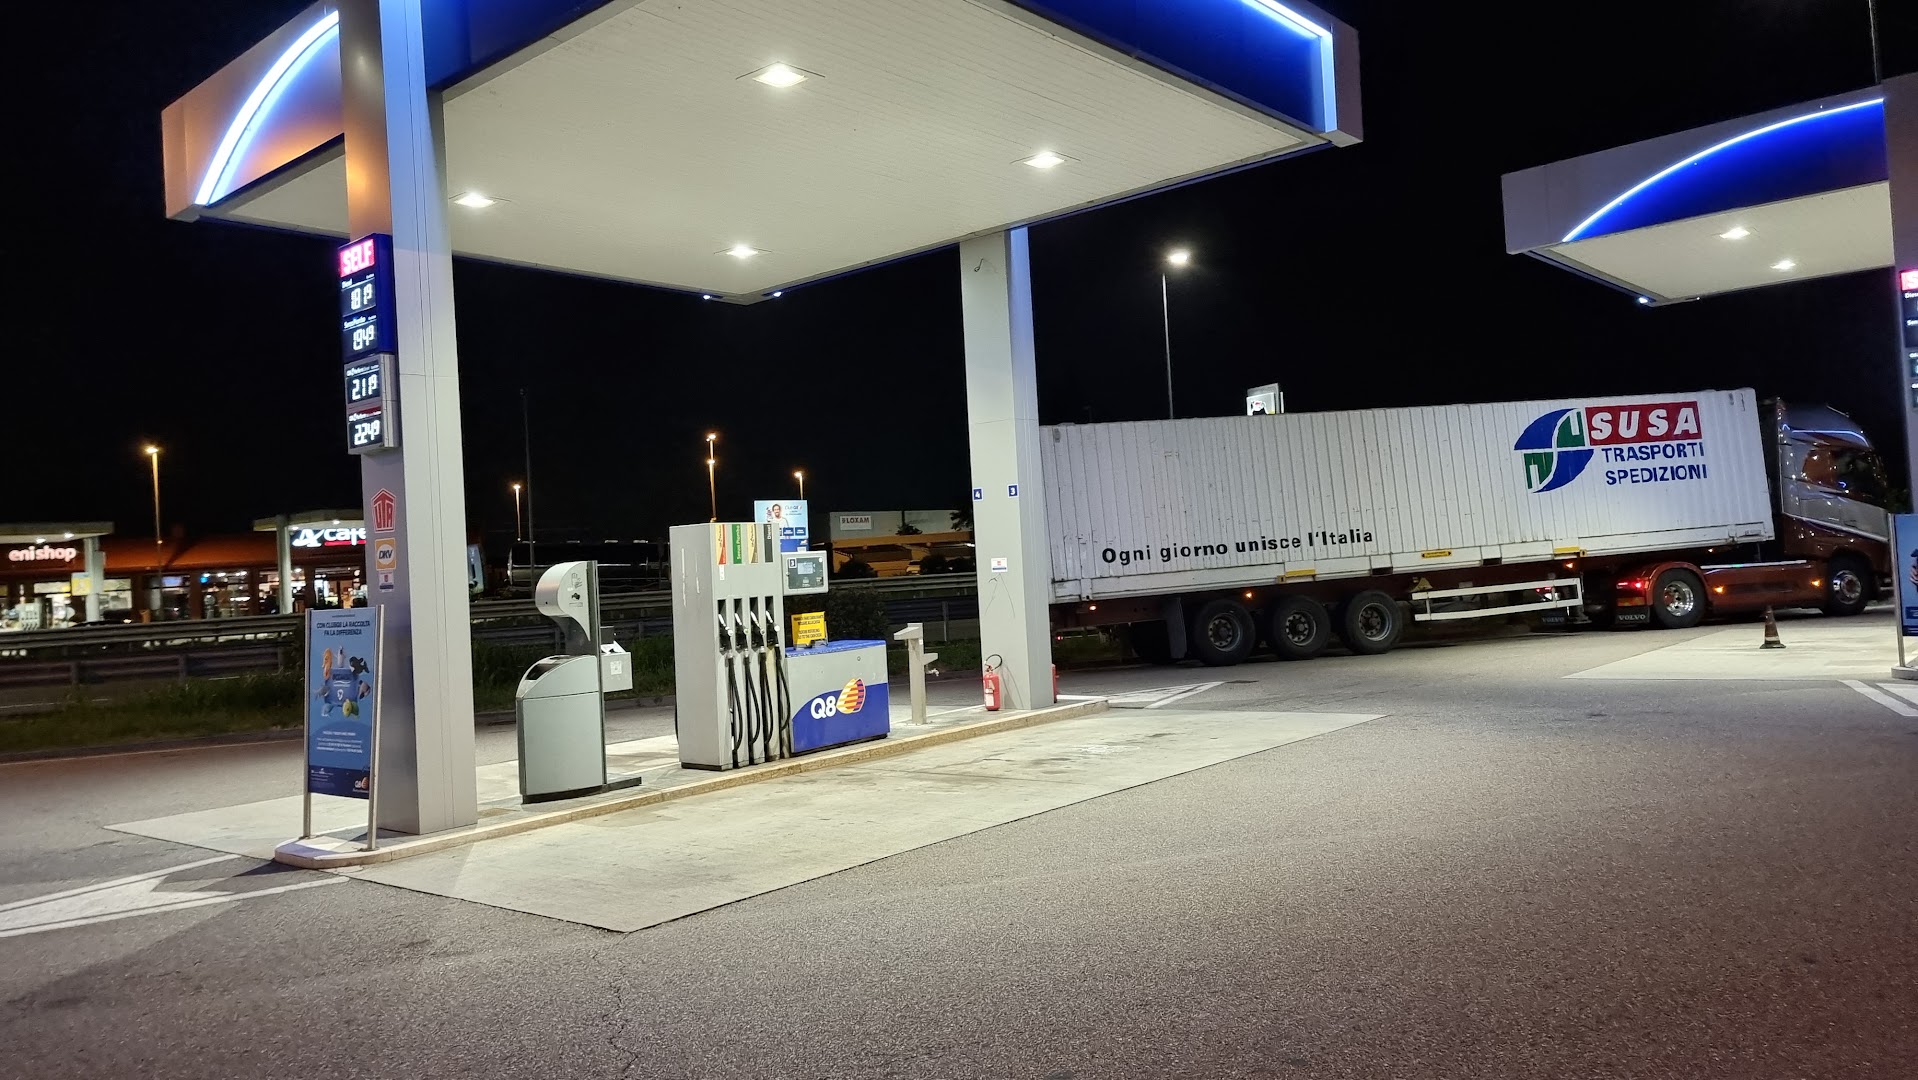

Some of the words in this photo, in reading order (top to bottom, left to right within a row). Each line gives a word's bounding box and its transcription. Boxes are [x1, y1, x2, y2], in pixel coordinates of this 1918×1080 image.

[343, 240, 372, 273] SELF
[1590, 407, 1699, 440] SUSA
[1601, 442, 1705, 463] TRASPORTI
[1605, 464, 1708, 485] SPEDIZIONI
[379, 549, 393, 559] DKV
[1102, 545, 1151, 565] Ogni
[1160, 543, 1228, 562] giorno
[1235, 536, 1301, 553] unisce
[1308, 529, 1373, 546] l'Italia
[811, 695, 836, 719] Q8
